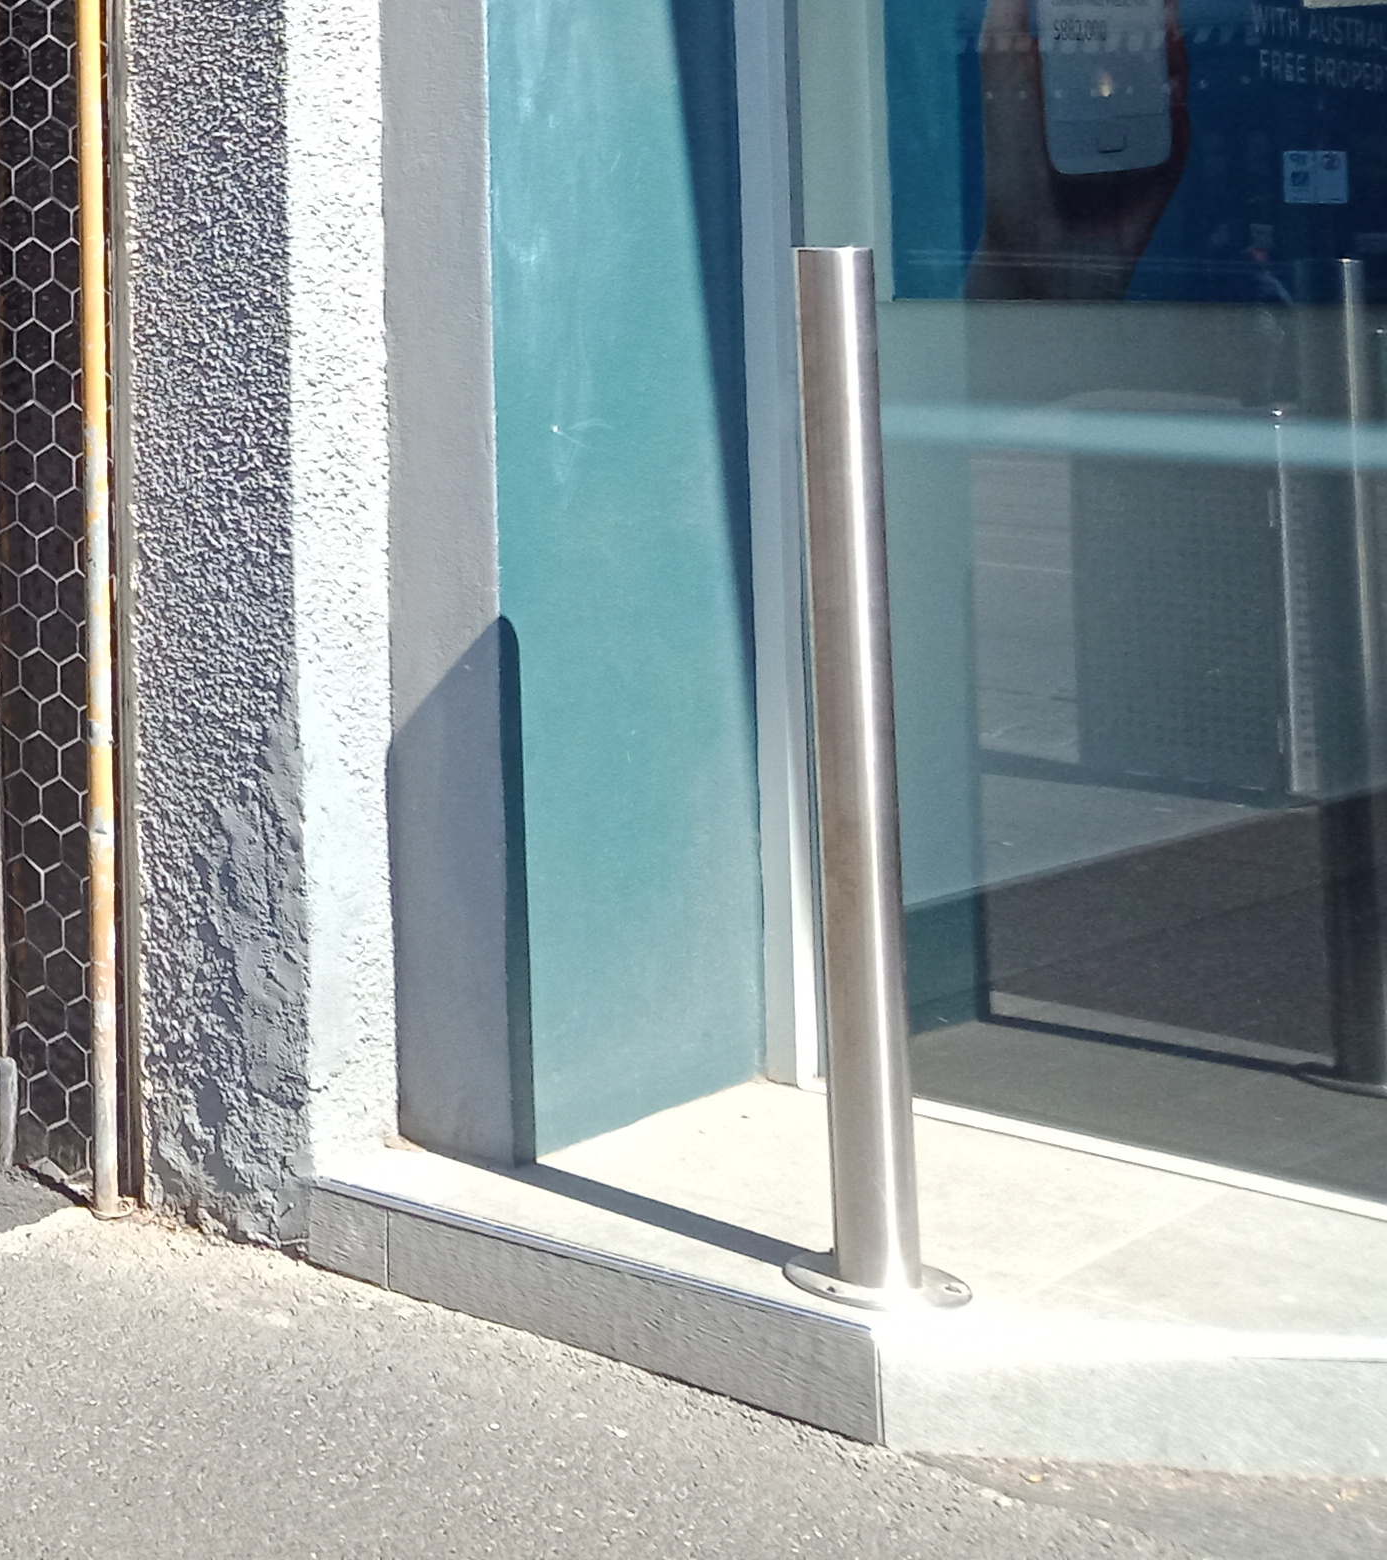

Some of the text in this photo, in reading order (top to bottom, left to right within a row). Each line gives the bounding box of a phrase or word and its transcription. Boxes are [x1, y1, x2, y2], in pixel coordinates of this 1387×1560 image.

[1250, 3, 1299, 37] WITH
[1259, 48, 1387, 92] FREE PROPER
